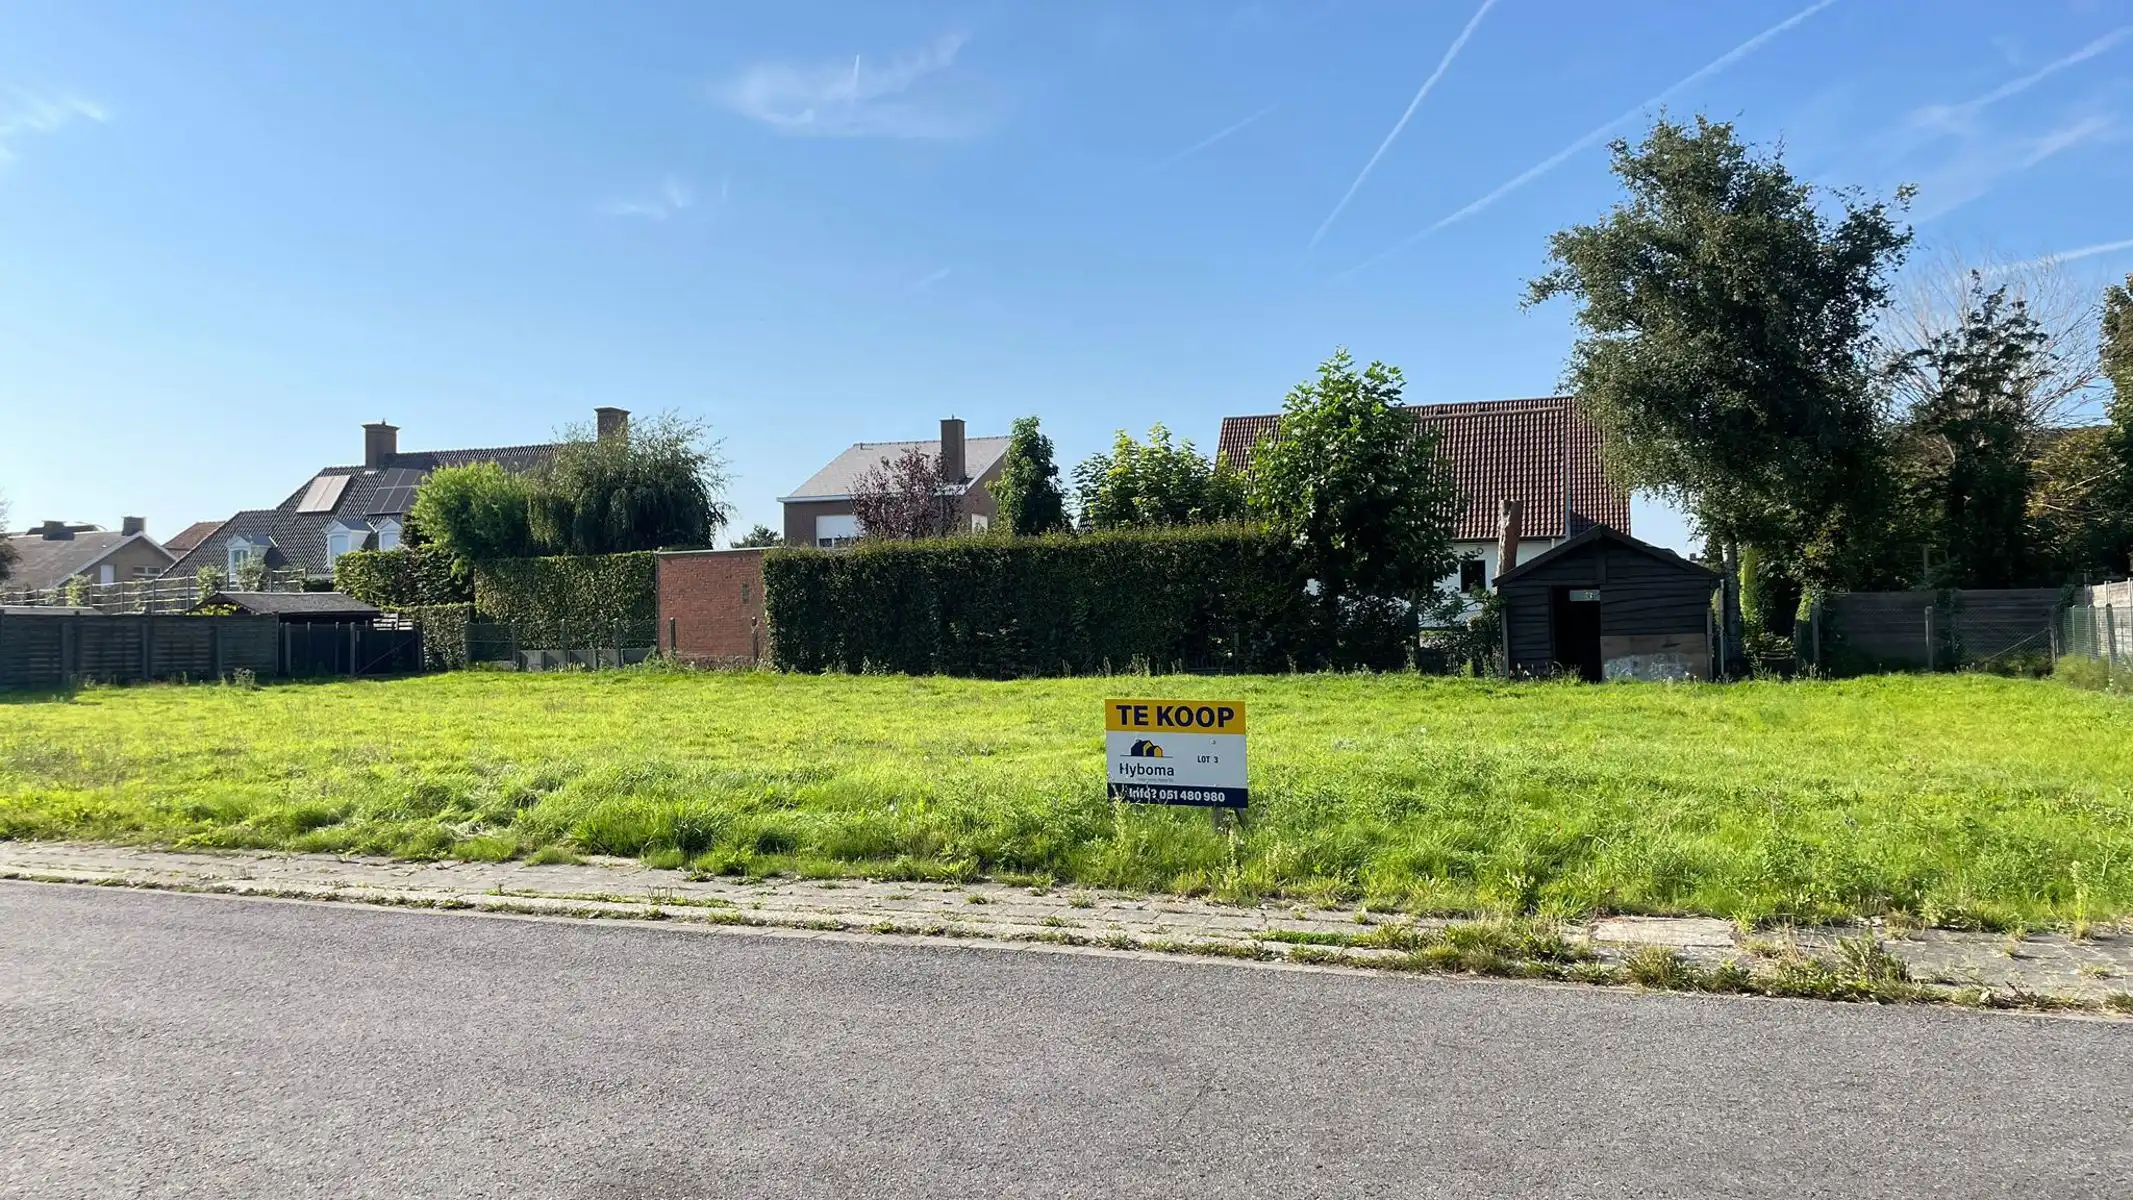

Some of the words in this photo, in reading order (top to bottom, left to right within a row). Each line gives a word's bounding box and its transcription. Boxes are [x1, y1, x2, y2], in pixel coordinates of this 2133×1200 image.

[1116, 704, 1149, 726] TE
[1156, 705, 1235, 728] KOOP
[1197, 755, 1210, 764] LOT
[1213, 756, 1219, 764] 3
[1119, 762, 1175, 778] Hyboma
[1159, 789, 1178, 800] 051
[1181, 790, 1202, 801] 480
[1203, 791, 1226, 802] 980
